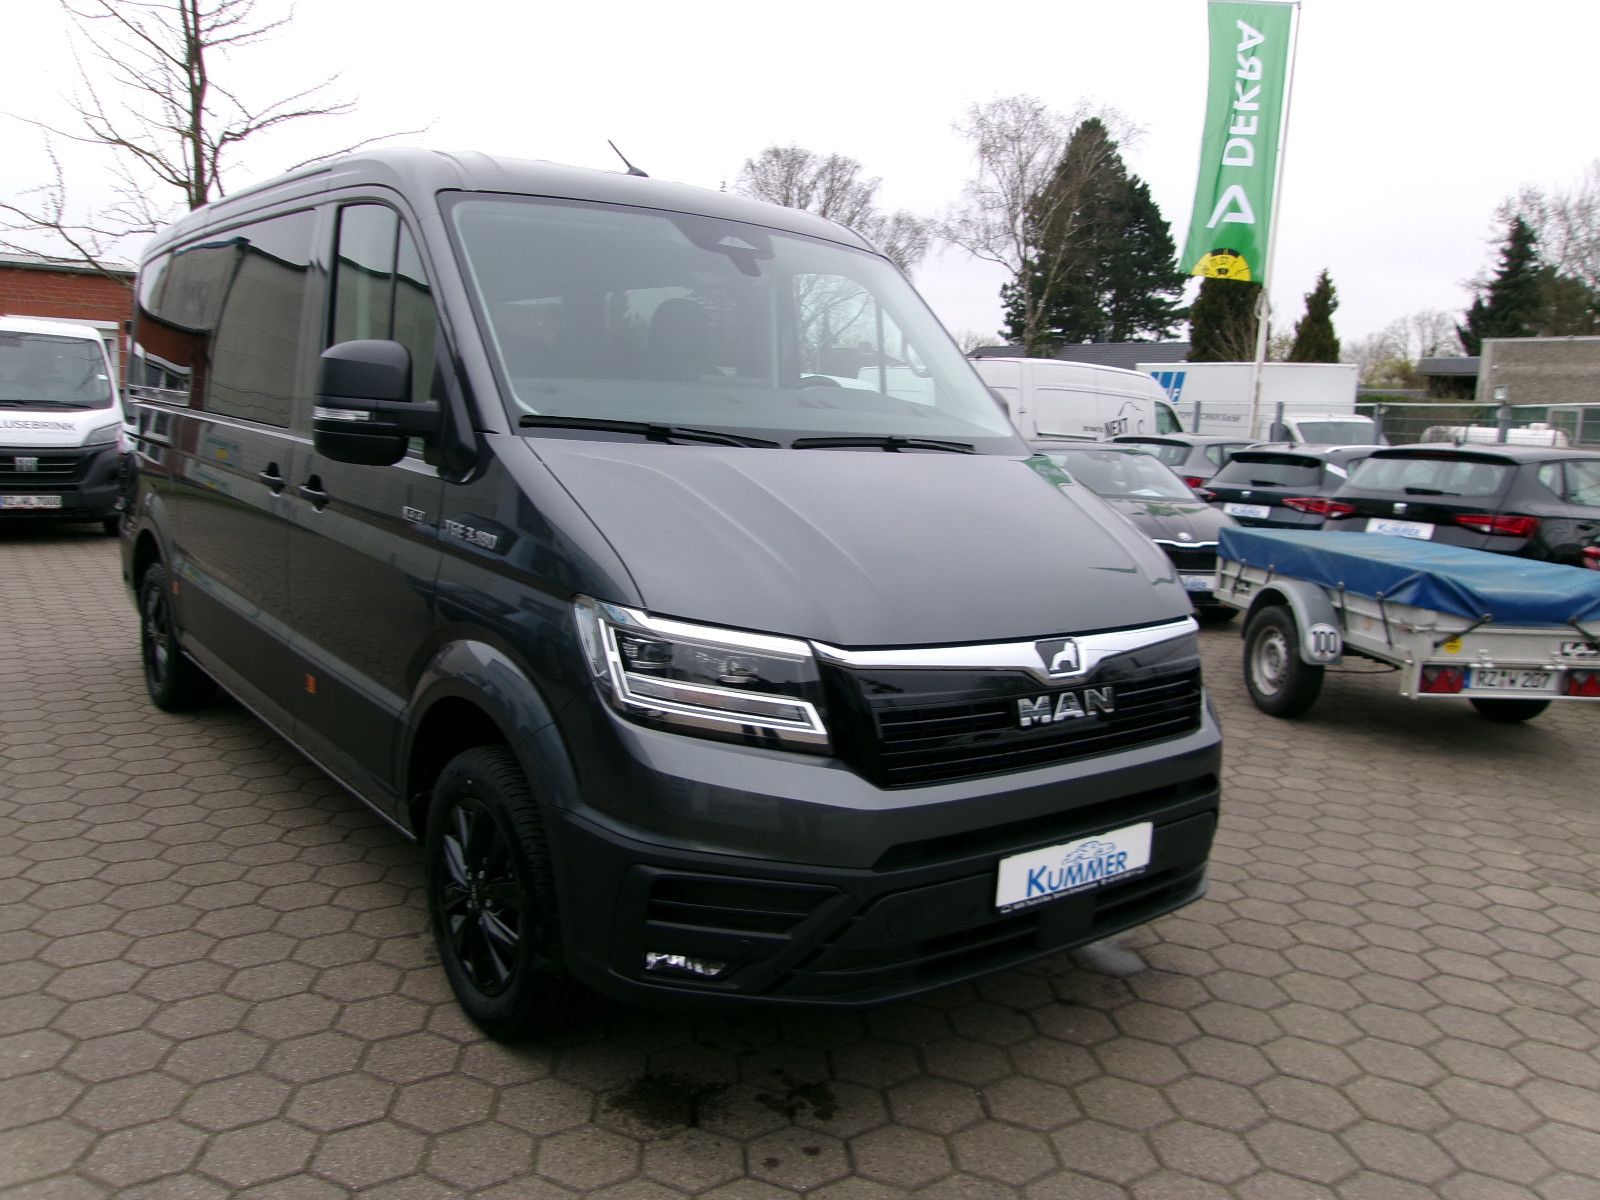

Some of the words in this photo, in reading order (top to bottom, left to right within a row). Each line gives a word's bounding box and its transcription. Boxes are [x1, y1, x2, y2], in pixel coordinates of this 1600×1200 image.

[1312, 631, 1337, 653] 100
[1017, 686, 1115, 728] MAN
[1026, 850, 1129, 898] KUMMER
